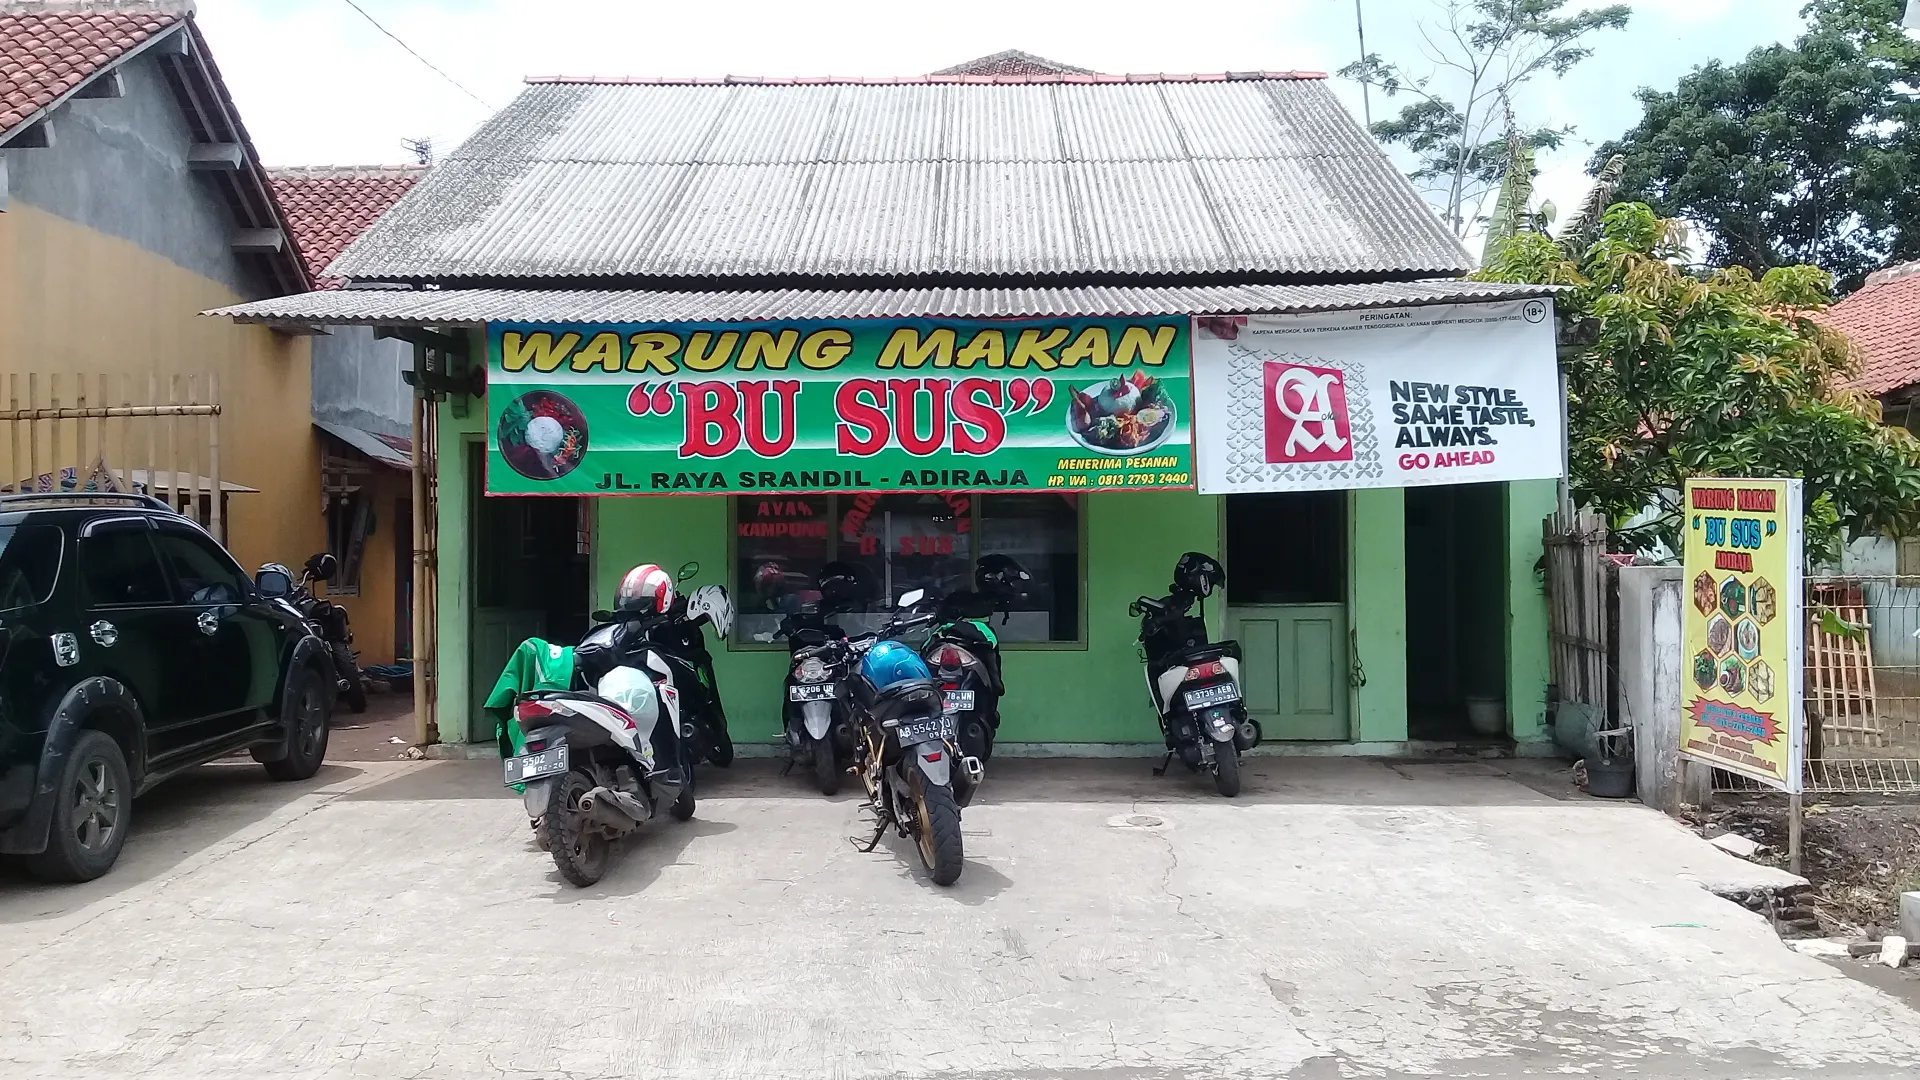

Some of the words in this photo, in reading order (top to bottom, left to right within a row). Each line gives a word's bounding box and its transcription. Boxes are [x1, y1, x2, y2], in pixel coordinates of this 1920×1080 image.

[1360, 312, 1412, 321] PERINGATAN:
[1526, 308, 1543, 316] 18+
[501, 328, 853, 375] WARUNG
[876, 325, 1178, 370] MAKAN
[1390, 380, 1449, 403] NEW
[1455, 385, 1523, 406] STYLE
[1392, 403, 1464, 425] SAME
[1466, 405, 1535, 427] TASTE,
[1395, 426, 1498, 448] ALWAYS.
[1058, 458, 1122, 471] MENERIMA
[1126, 456, 1178, 469] PESANAN
[1399, 453, 1430, 470] GO
[1434, 450, 1495, 468] AHEAD
[595, 472, 640, 489] JL.
[652, 472, 727, 489] RAYA
[739, 470, 872, 488] SRANDIL
[900, 469, 1029, 488] ADIRAJA
[1069, 475, 1087, 486] WA
[1098, 474, 1124, 485] 0813
[1127, 473, 1155, 485] 2793
[1159, 473, 1188, 484] 2440
[1691, 487, 1735, 511] WARUNG
[1737, 488, 1776, 513] MAKAN
[1715, 550, 1753, 574] ADIRAJA
[1195, 689, 1214, 699] 3736
[1217, 685, 1232, 694] AEB
[899, 726, 911, 738] AB
[912, 721, 938, 734] 5542
[507, 761, 514, 771] R
[522, 754, 546, 767] 5502
[558, 749, 565, 760] F
